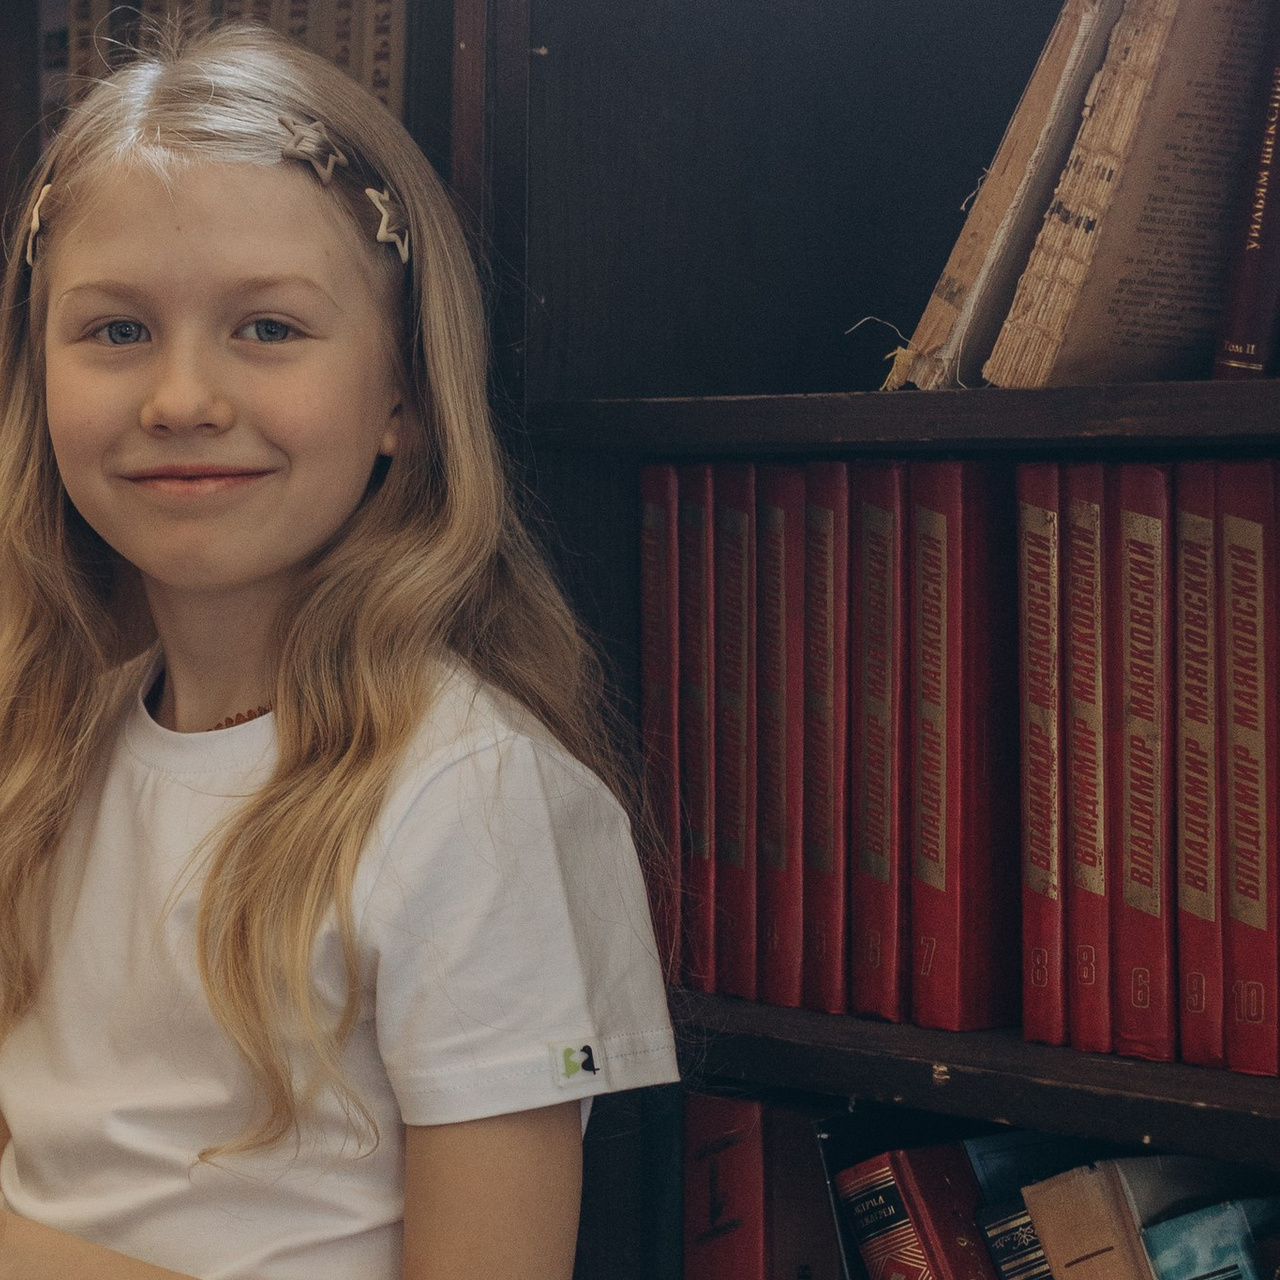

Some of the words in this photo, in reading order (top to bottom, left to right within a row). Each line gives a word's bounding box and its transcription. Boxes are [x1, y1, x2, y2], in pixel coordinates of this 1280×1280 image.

[1245, 170, 1270, 252] УИЛЬЯМ
[867, 531, 889, 702] МАЯКОВСКИЙ
[921, 531, 943, 706] МАЯКОВСКИЙ
[1024, 531, 1051, 709] МАЯКОВСКИЙ
[1071, 524, 1097, 704] МАЯКОВСКИЙ
[1127, 538, 1156, 722] МАЯКОВСКИЙ
[1181, 540, 1209, 725] МАЯКОВСКИЙ
[1229, 544, 1260, 732] МАЯКОВСКИЙ
[865, 716, 888, 858] ВЛАДИМИР
[920, 718, 942, 864] ВЛАДИМИР
[1028, 723, 1052, 871] ВЛАДИМИР
[1073, 718, 1099, 867] ВЛАДИМИР
[1130, 735, 1155, 889] ВЛАДИМИР
[1185, 738, 1210, 893] ВЛАДИМИР
[1233, 744, 1262, 902] ВЛАДИМИР
[920, 936, 937, 977] 7
[1031, 947, 1049, 988] 8
[1076, 944, 1096, 988] 8
[1131, 967, 1151, 1009] 6
[1186, 971, 1207, 1014] 9
[1232, 979, 1266, 1024] 10
